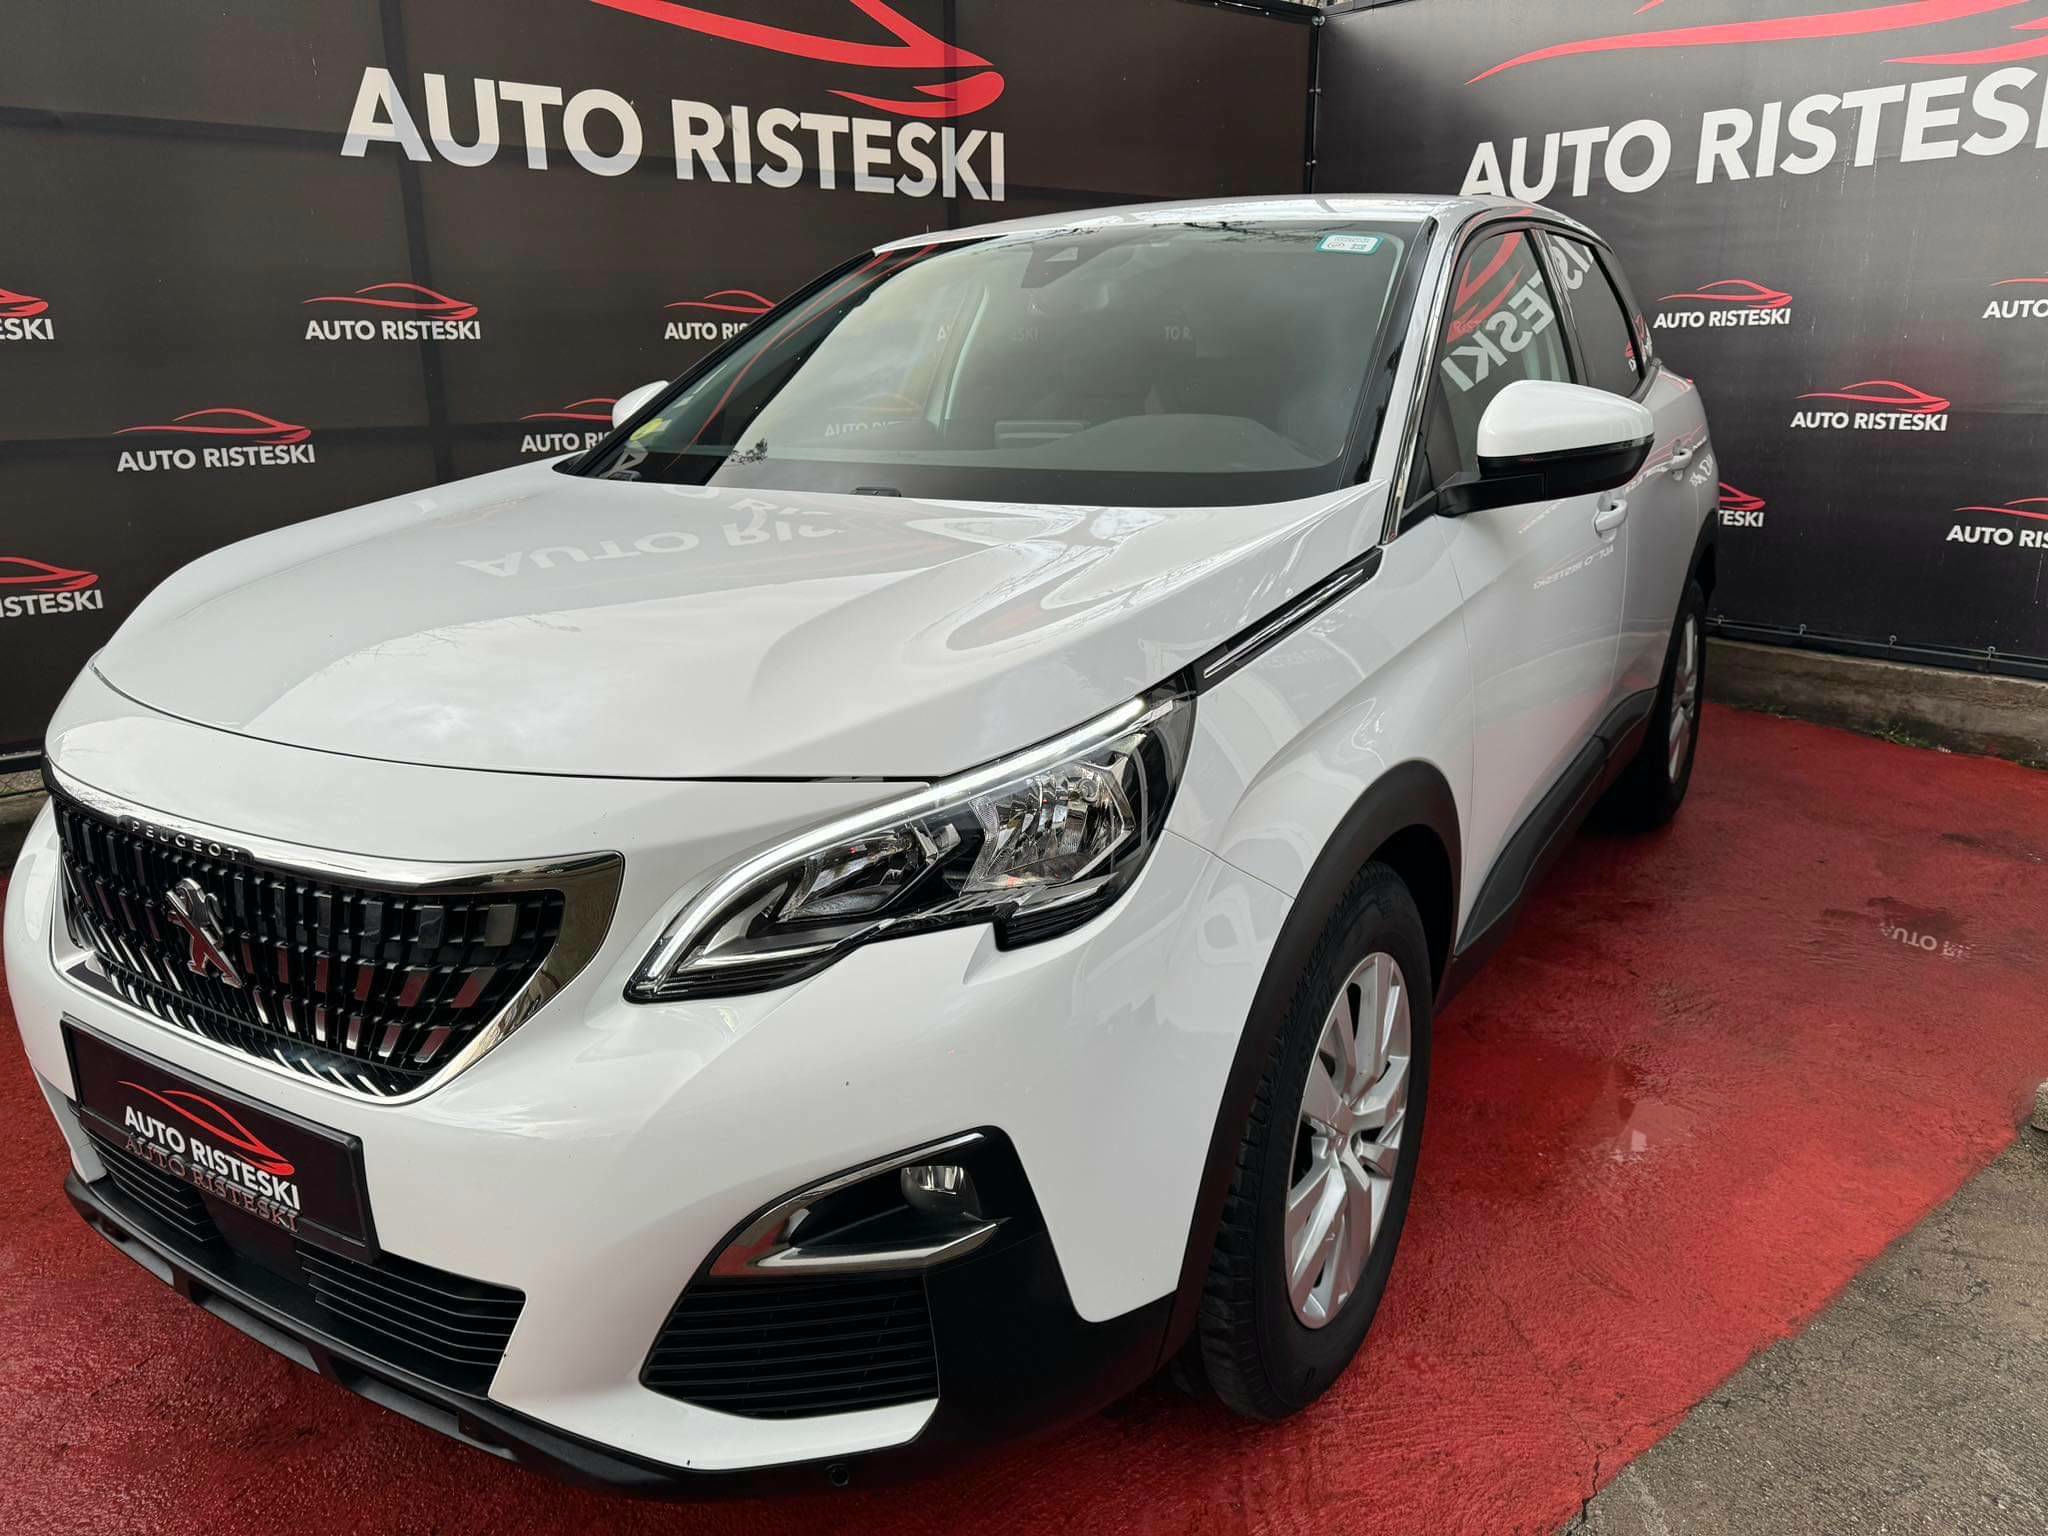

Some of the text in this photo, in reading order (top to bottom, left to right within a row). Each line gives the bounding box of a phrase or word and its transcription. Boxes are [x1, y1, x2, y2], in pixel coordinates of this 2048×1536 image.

[341, 67, 1004, 201] AUTO RISTESKI
[1459, 67, 2048, 203] AUTO RISTES
[1653, 308, 1791, 329] AUTO RISTESKI
[1982, 299, 2048, 319] AUTO
[306, 320, 481, 341] AUTO RISTESKI
[664, 322, 718, 340] AUTO
[1790, 411, 1948, 431] AUTO RISTESKI
[521, 432, 580, 453] AUTO
[117, 444, 315, 472] AUTO RISTESKI
[1945, 525, 2014, 546] AUTO
[131, 820, 239, 861] PEUGEOT
[125, 1105, 301, 1211] AUTO RISTESKI
